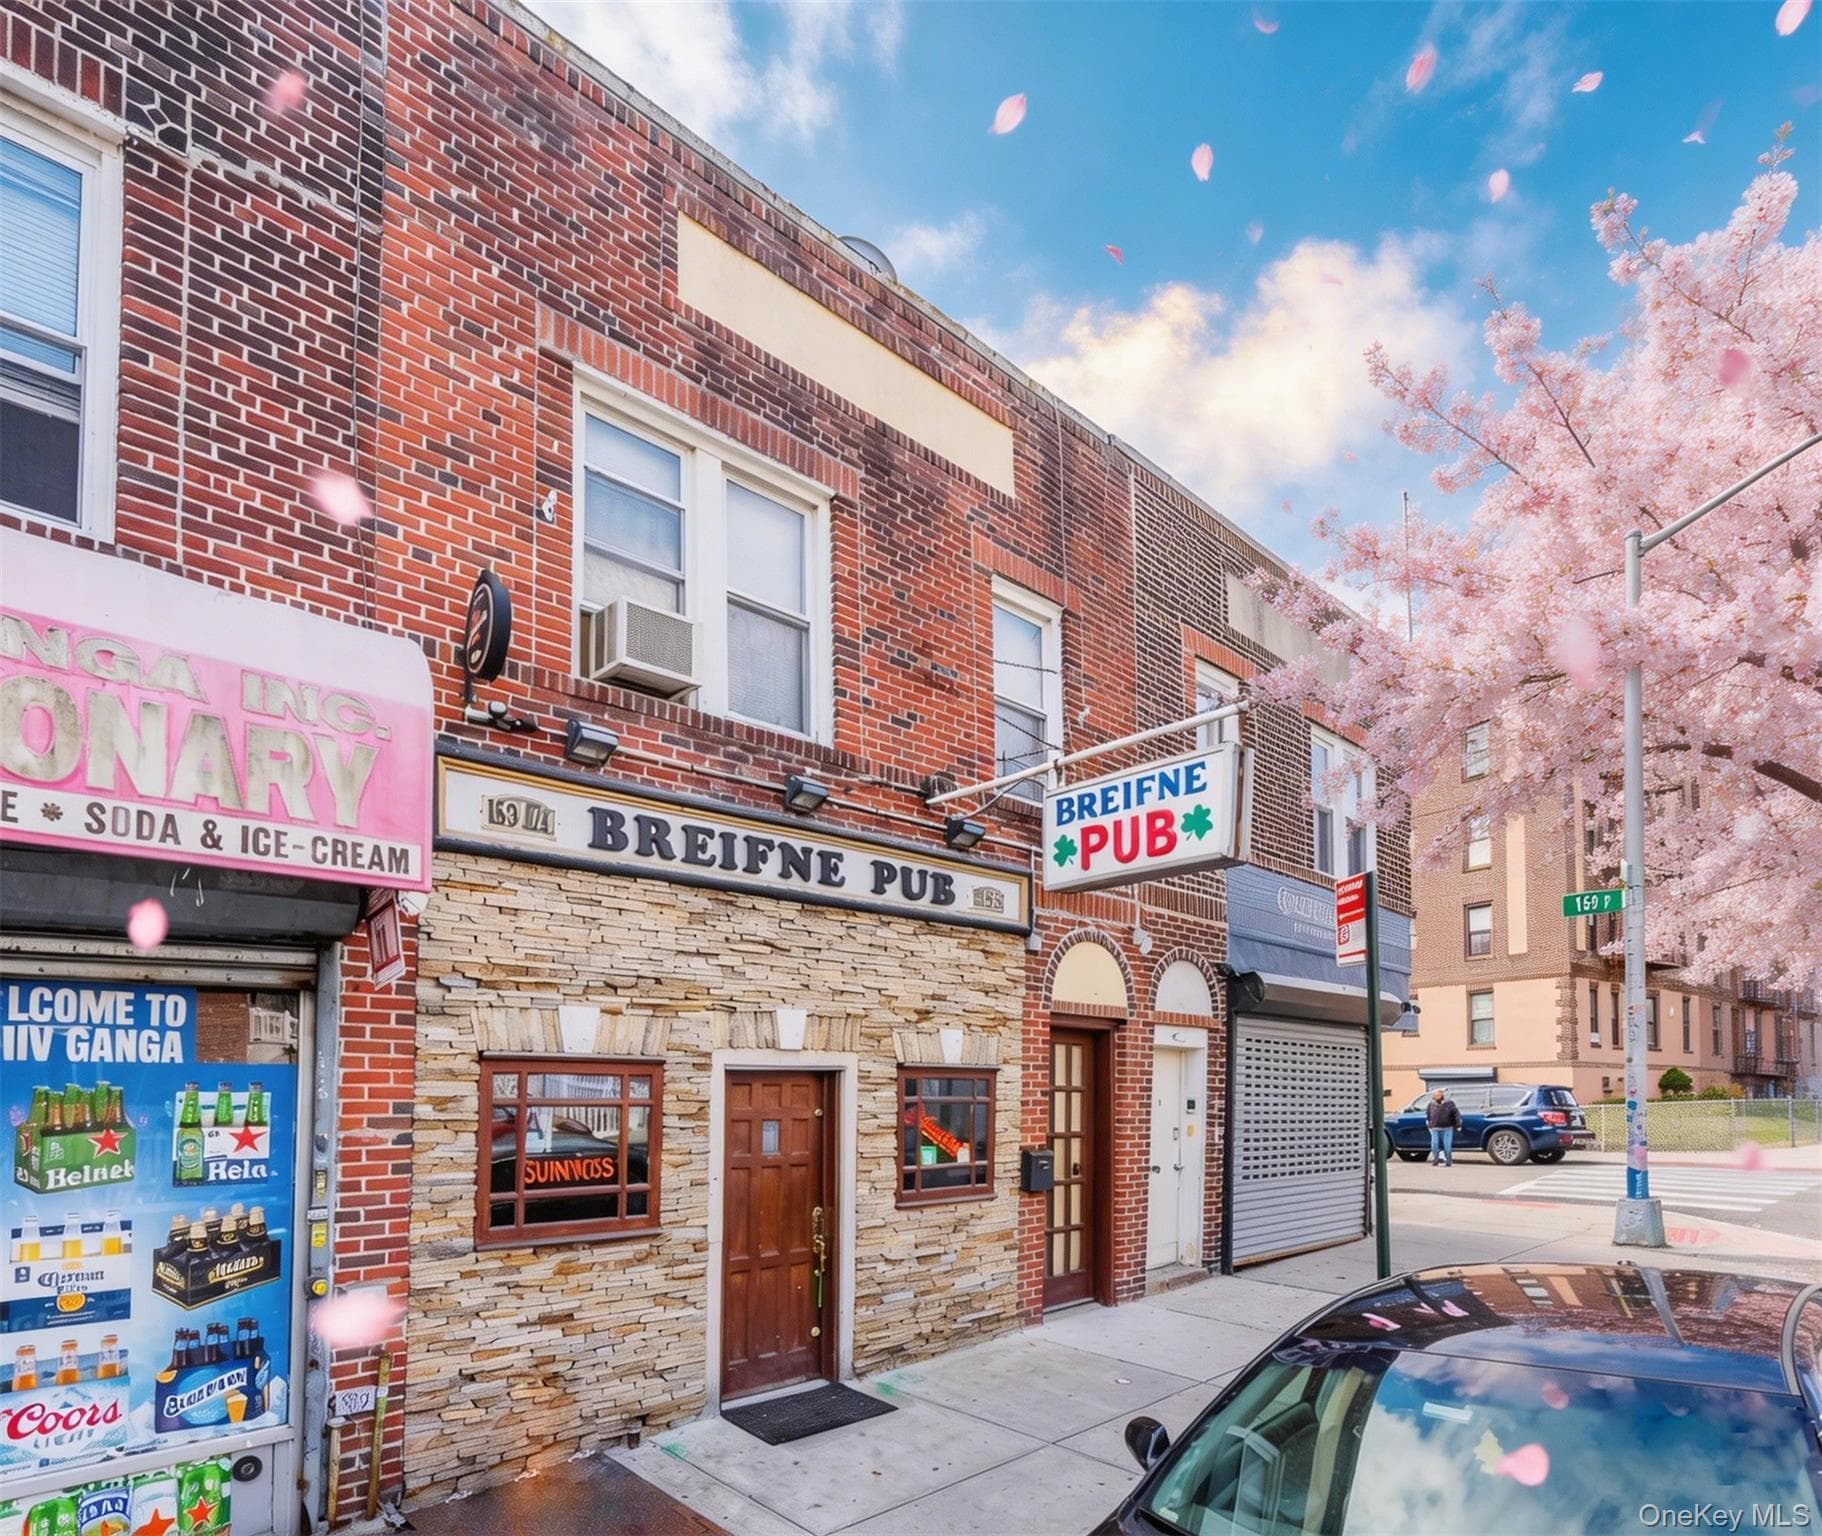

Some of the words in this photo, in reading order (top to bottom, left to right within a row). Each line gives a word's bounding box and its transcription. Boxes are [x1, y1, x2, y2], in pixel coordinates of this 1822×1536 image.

[242, 669, 393, 742] INC.
[1056, 761, 1208, 827] BREIFNE
[85, 802, 181, 845] SODA
[201, 819, 223, 851] &
[241, 825, 410, 875] ICE-CREAM
[588, 806, 846, 888] BREIFNE
[871, 859, 957, 906] PUB
[1080, 808, 1178, 872] PUB
[146, 993, 187, 1027] TO
[66, 1027, 184, 1064] GANGA
[7, 1399, 122, 1440] Coors
